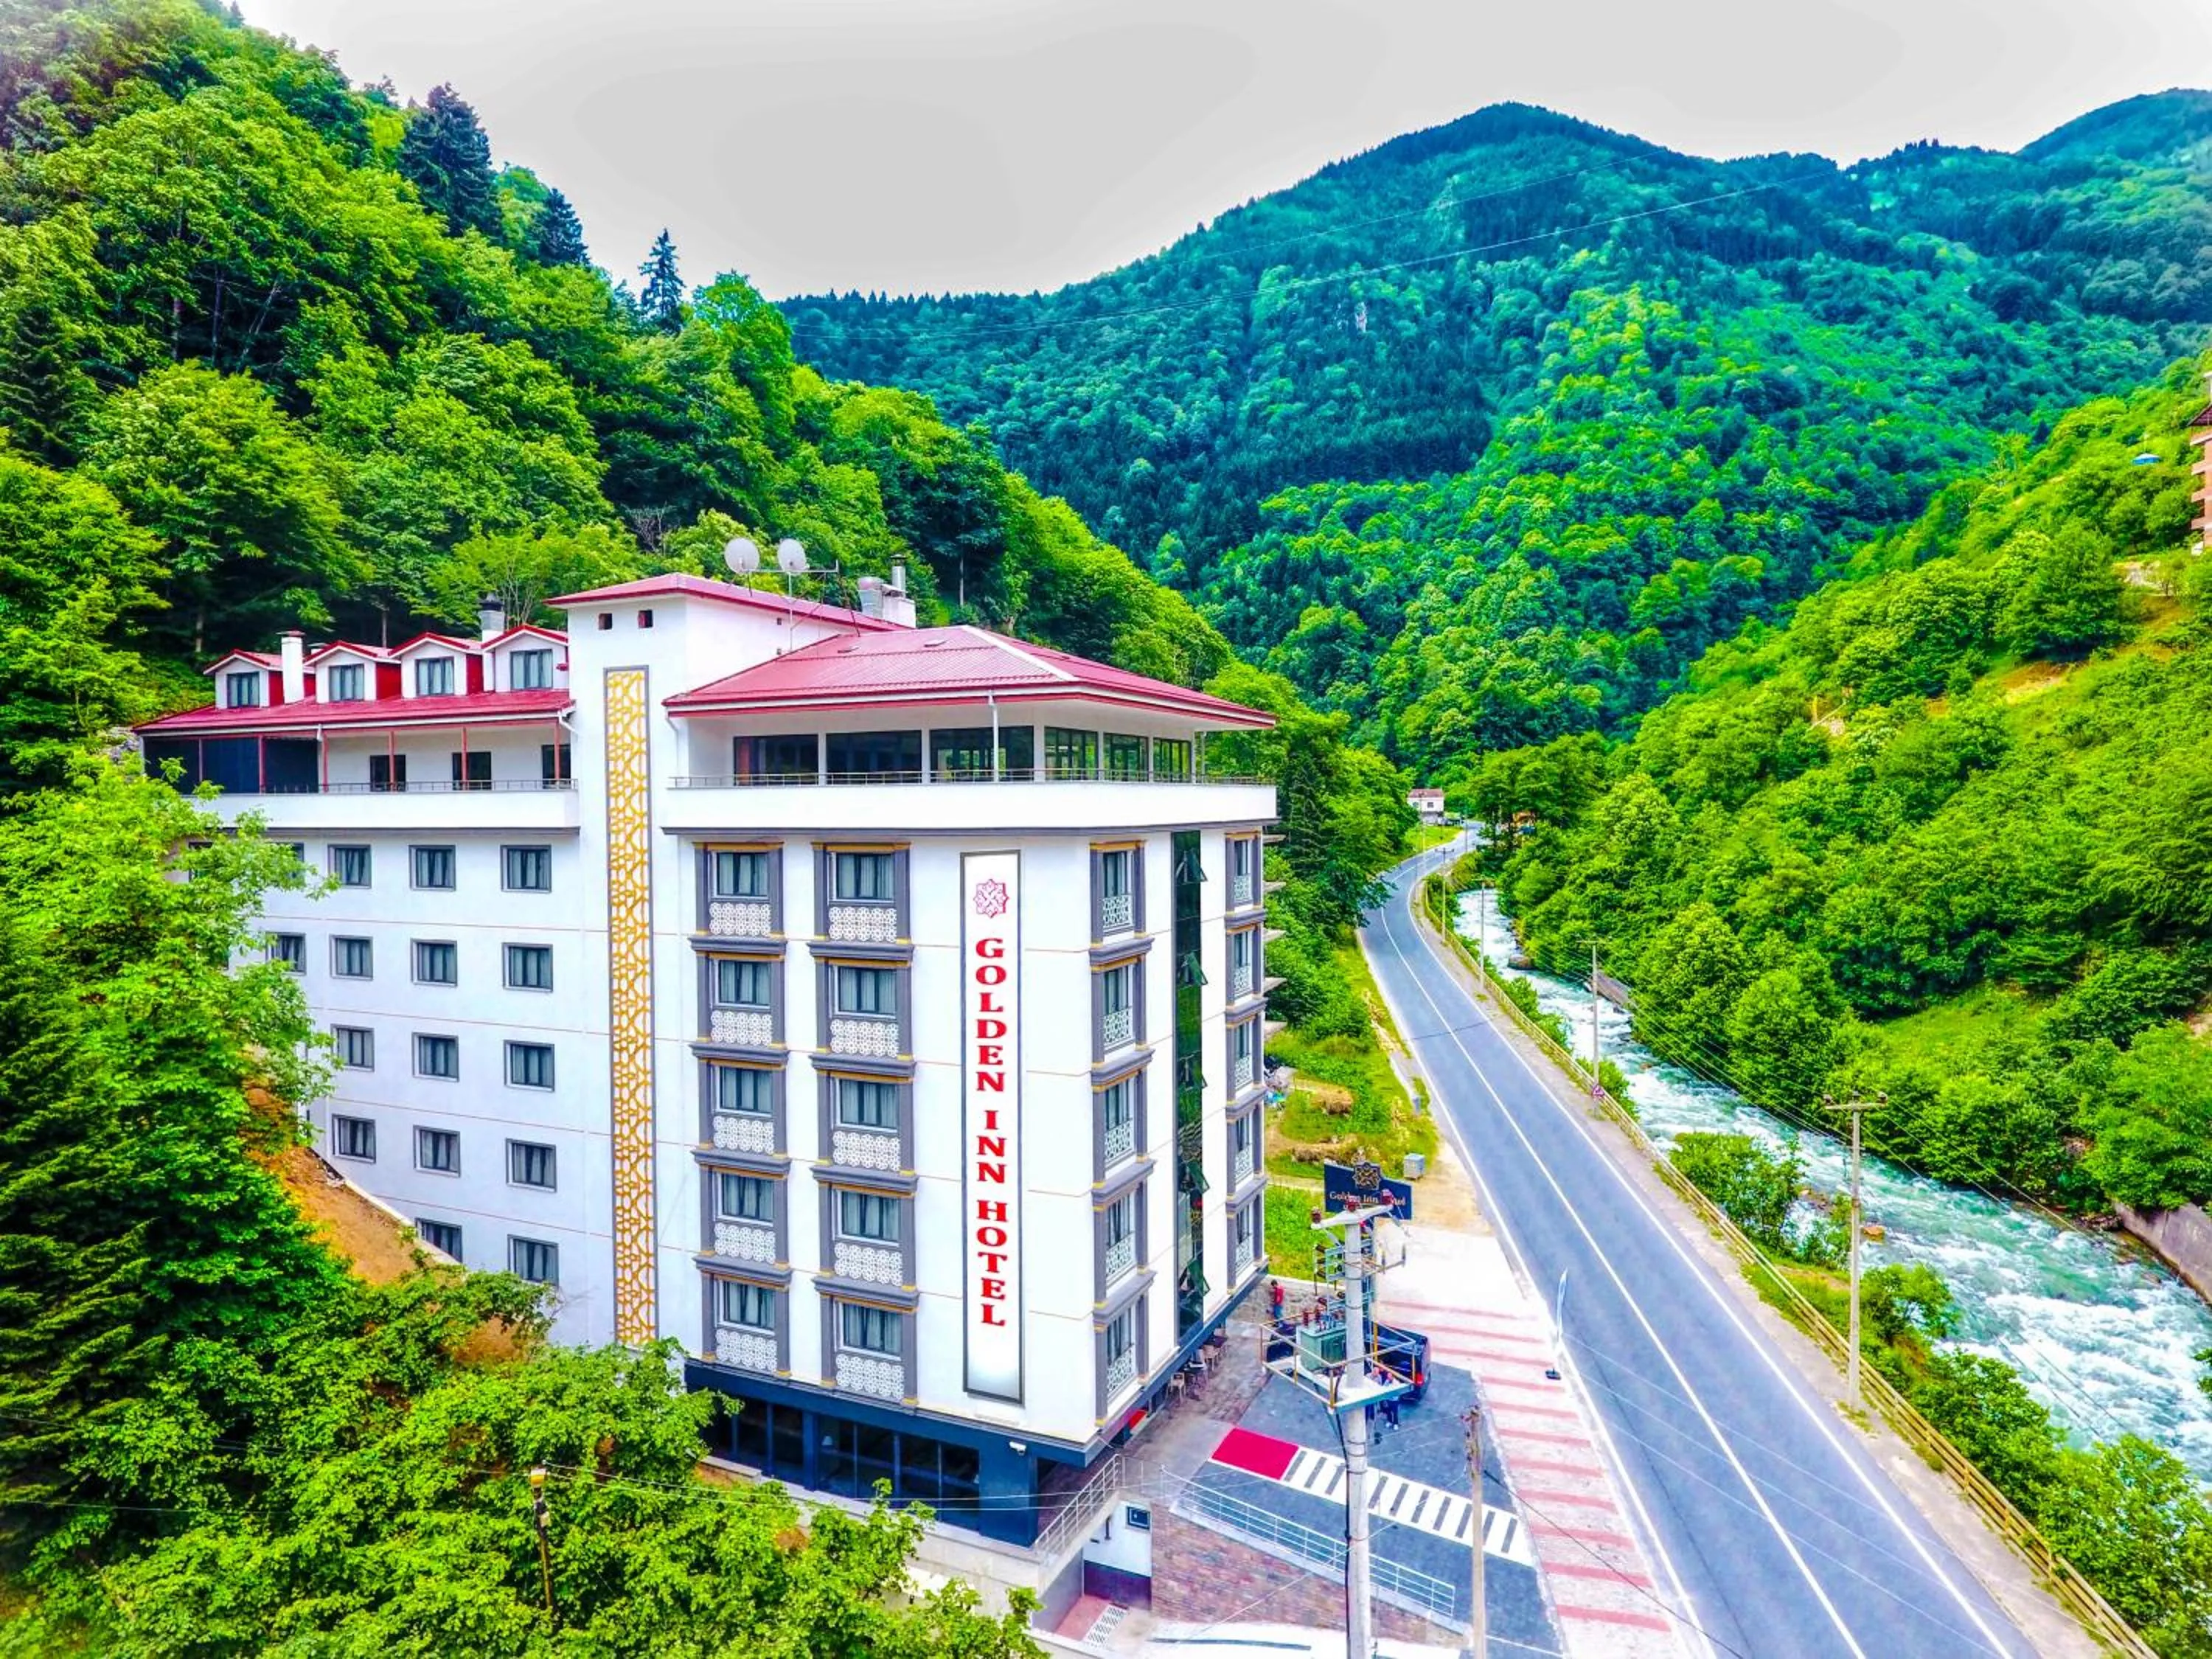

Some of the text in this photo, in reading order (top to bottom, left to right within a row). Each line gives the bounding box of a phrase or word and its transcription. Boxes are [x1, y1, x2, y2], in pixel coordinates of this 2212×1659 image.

[975, 937, 1008, 1327] GOLDEN INN HOTEL
[1329, 1191, 1361, 1203] Gold
